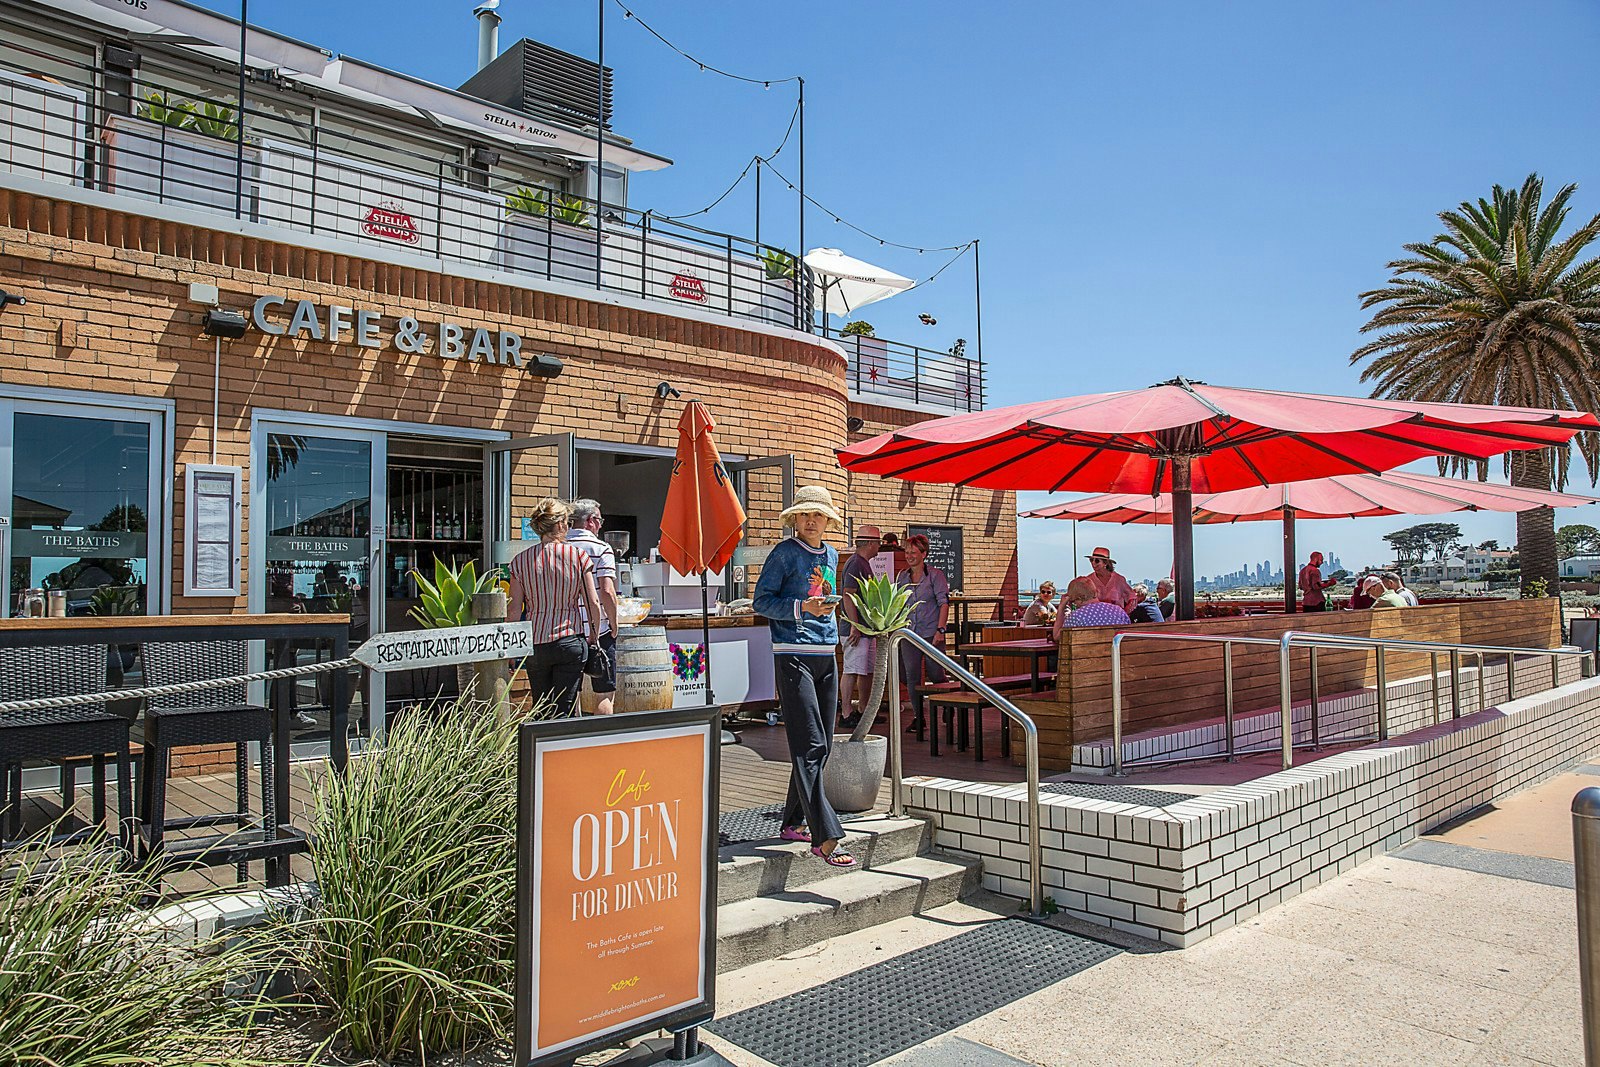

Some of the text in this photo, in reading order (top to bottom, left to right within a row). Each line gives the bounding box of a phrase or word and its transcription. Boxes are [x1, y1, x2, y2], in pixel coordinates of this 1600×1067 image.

[484, 113, 558, 140] STELLA ARTOIS
[372, 213, 410, 228] STELLA
[675, 279, 701, 291] STELLA
[252, 294, 522, 367] CAFE & BAR
[42, 535, 120, 547] THE BATHS
[288, 541, 349, 552] THE BATHS
[501, 630, 528, 650] BAR
[624, 681, 636, 689] DE
[635, 688, 660, 696] WINES
[606, 768, 651, 807] Cafe
[572, 799, 681, 882] OPEN
[571, 871, 678, 921] FOR DINNER
[586, 942, 598, 950] The
[599, 936, 617, 947] Baths
[617, 932, 632, 942] Cafe
[638, 928, 653, 938] open
[653, 924, 664, 934] late
[597, 950, 606, 959] all
[607, 944, 630, 956] through
[608, 975, 641, 994] xoxo
[578, 993, 666, 1024] www.middlebrightonbaths.com.au
